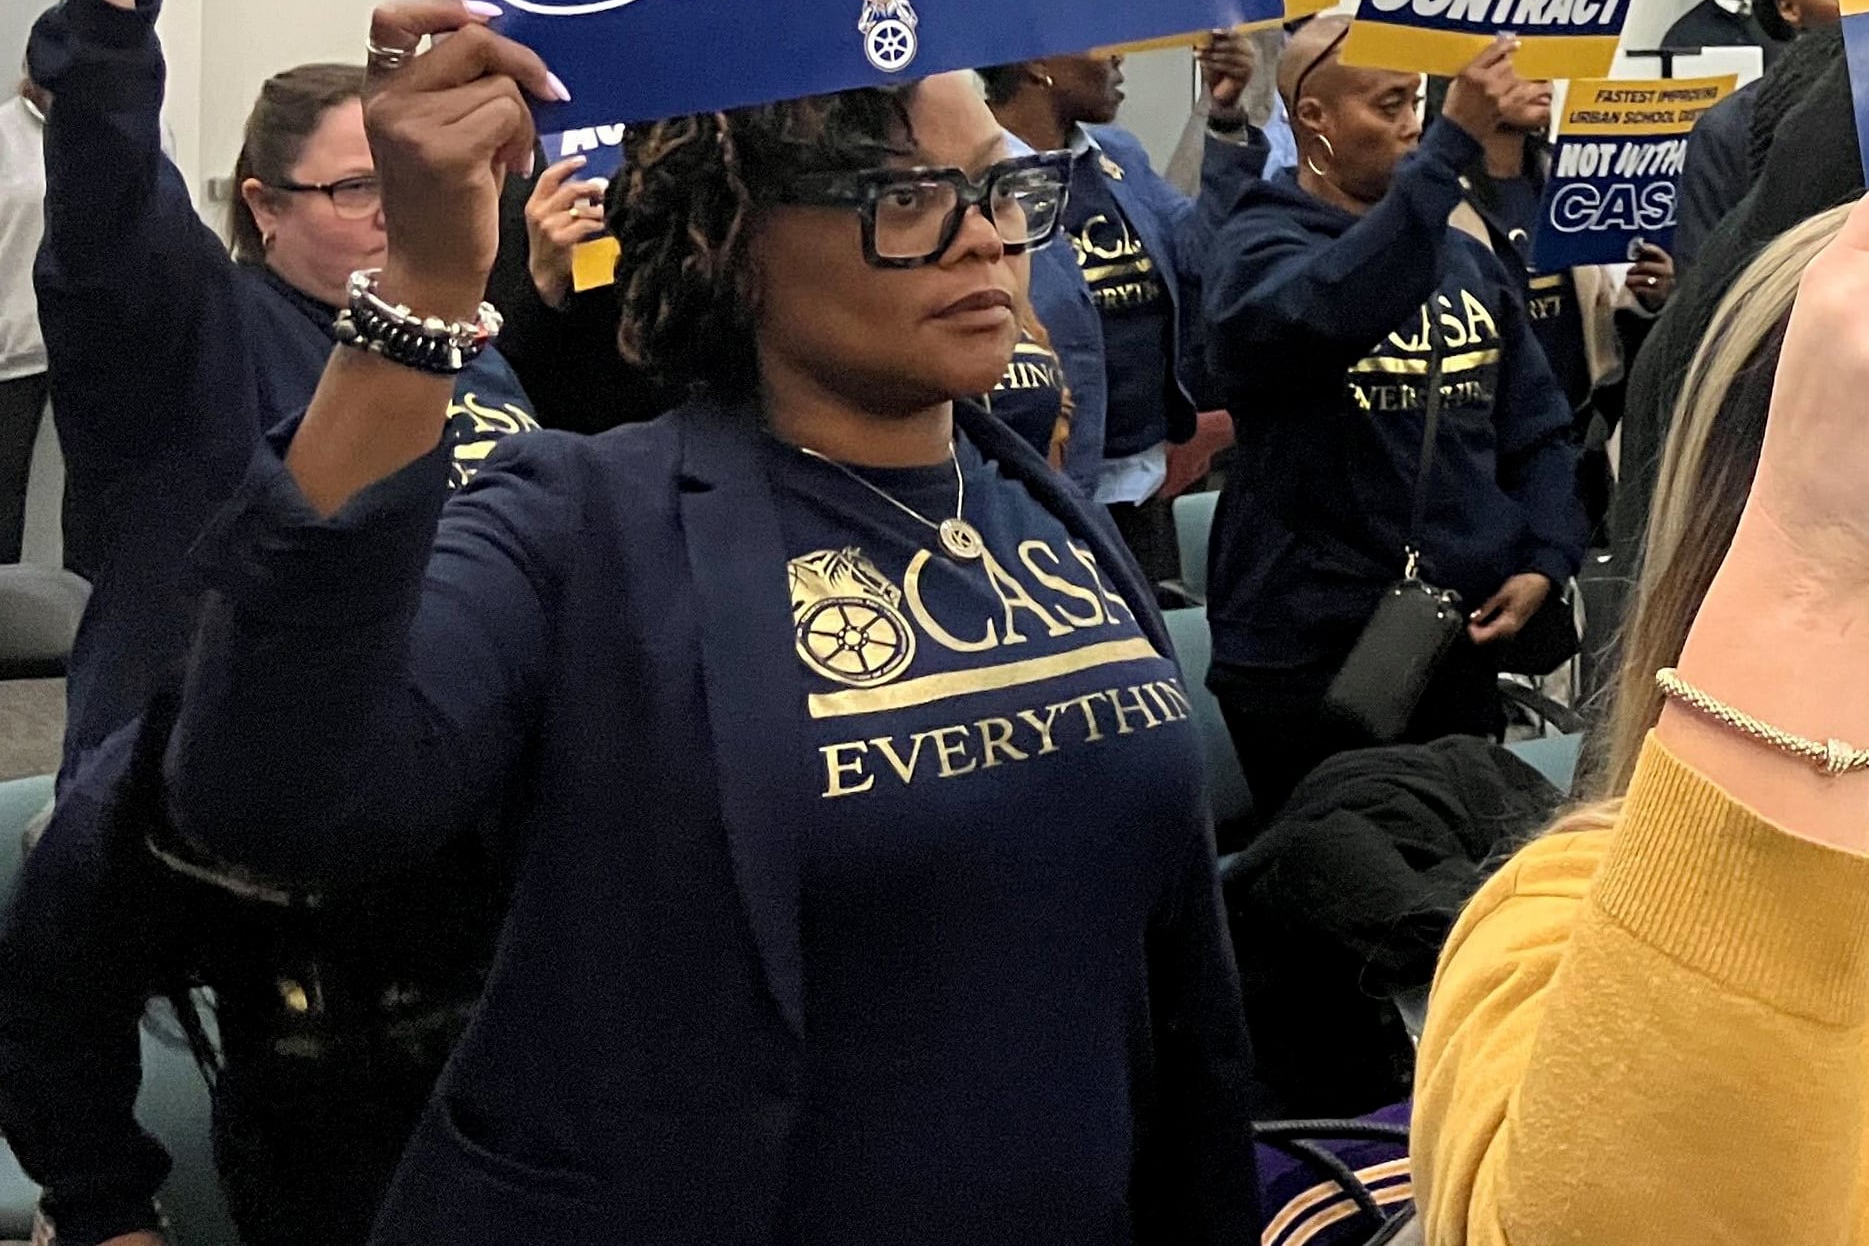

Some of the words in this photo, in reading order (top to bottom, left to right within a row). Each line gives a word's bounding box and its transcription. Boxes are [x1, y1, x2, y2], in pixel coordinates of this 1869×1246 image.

[1594, 90, 1655, 103] FASTEST
[1569, 111, 1621, 124] URBAN
[1624, 111, 1674, 123] SCHOOL
[1557, 143, 1617, 177] NOT
